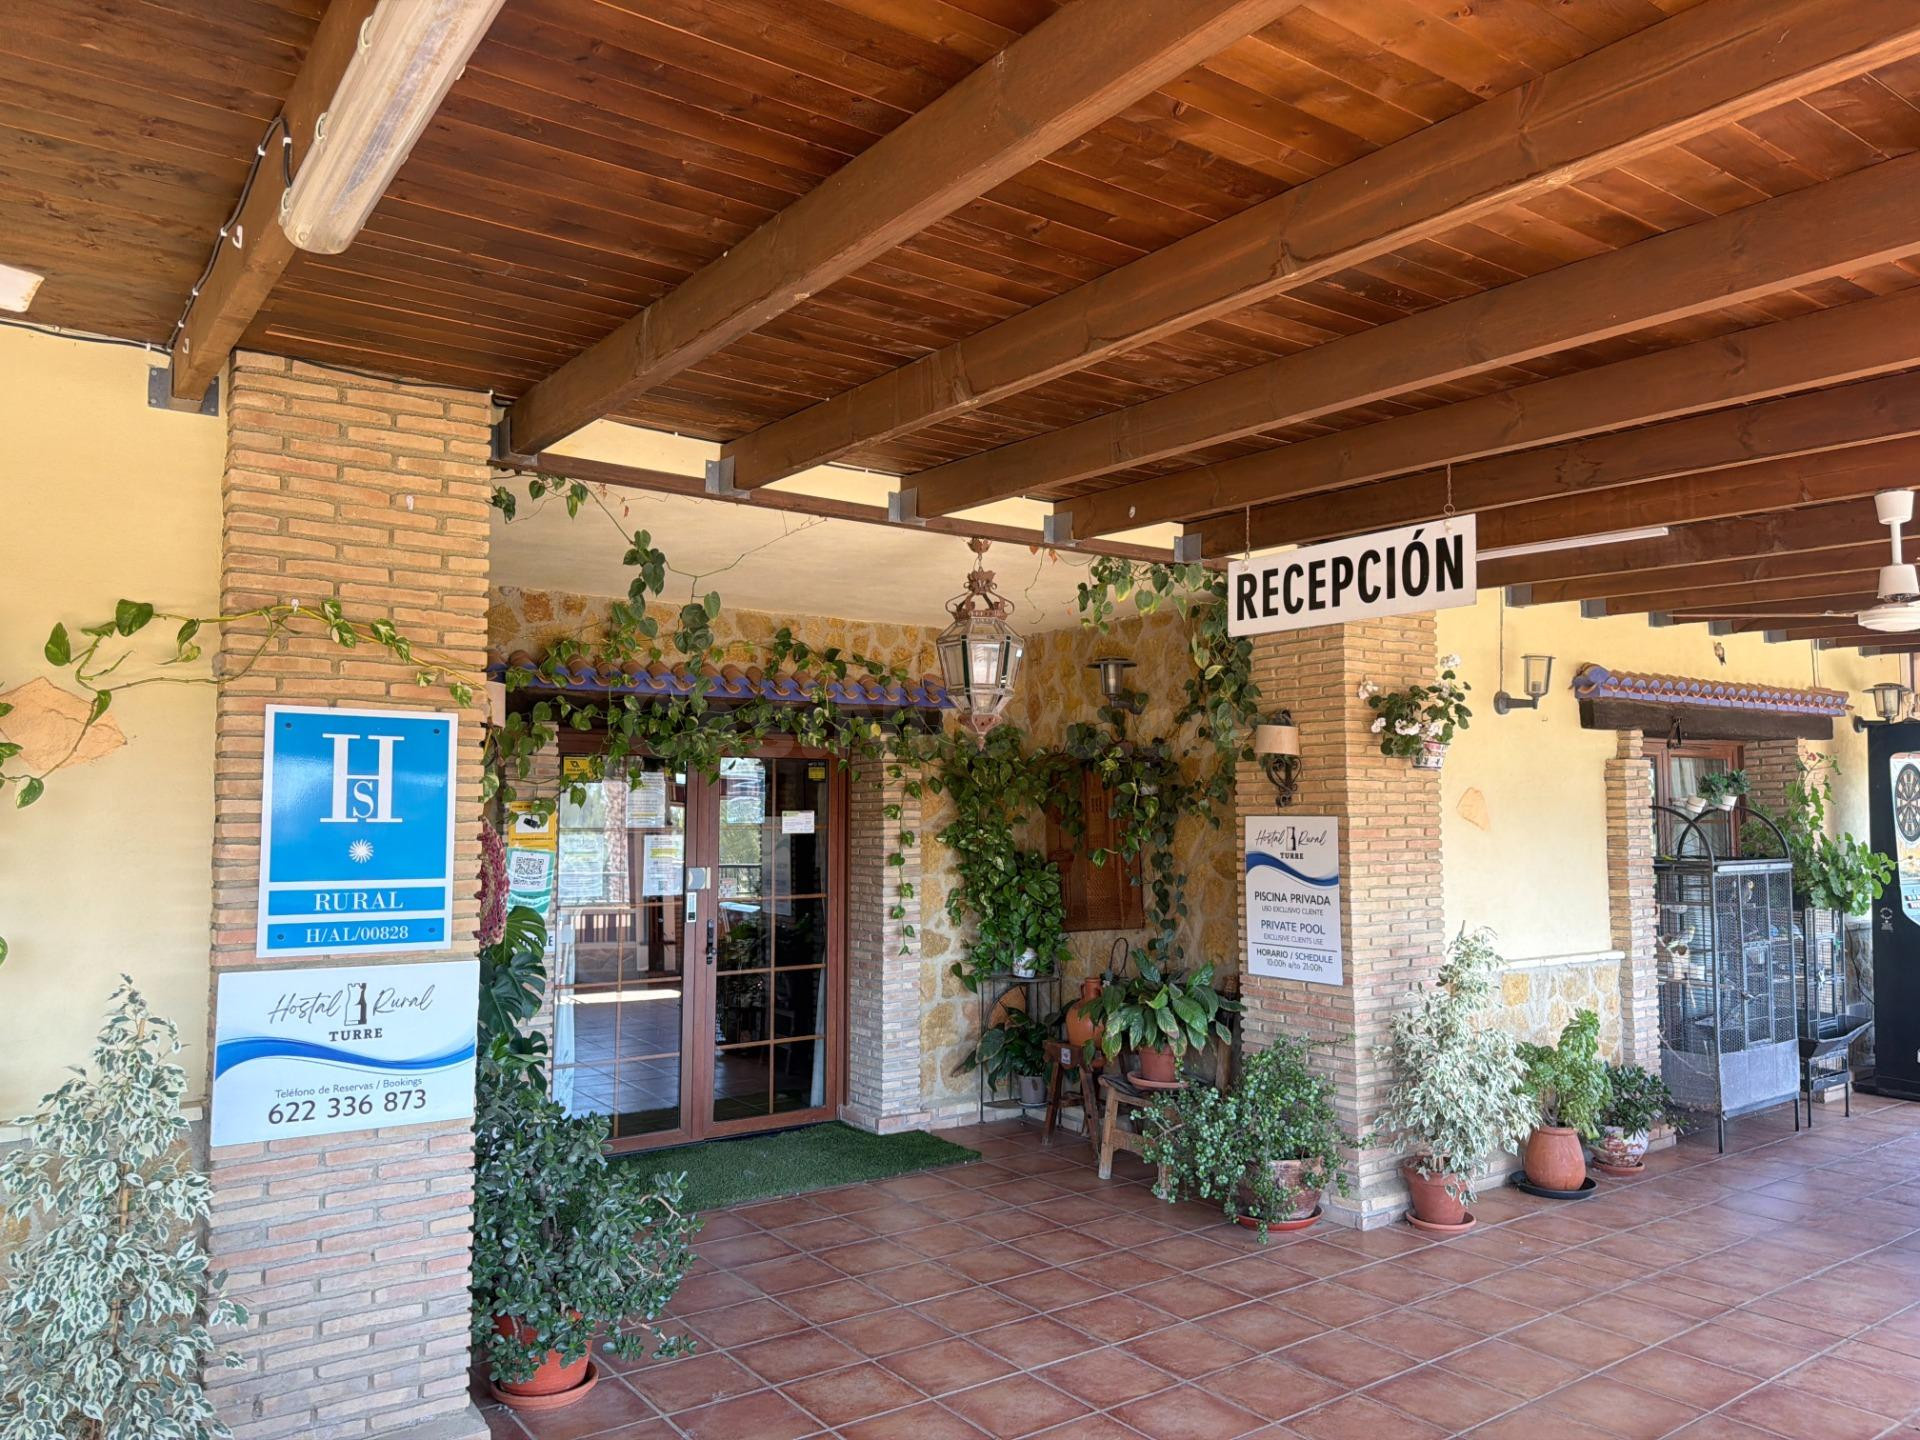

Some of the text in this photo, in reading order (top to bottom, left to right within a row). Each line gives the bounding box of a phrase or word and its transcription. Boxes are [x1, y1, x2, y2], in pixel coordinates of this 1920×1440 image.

[1236, 528, 1464, 621] RECEPCIÓN
[1255, 828, 1328, 848] Hostal Rural
[1279, 852, 1304, 860] TURRE
[313, 890, 405, 912] RURAL
[1254, 890, 1332, 906] PISCINA PRIVADA
[1261, 904, 1324, 916] USO EXCLUSIVO CLIENTE
[305, 924, 410, 944] H/AL/00828
[1260, 919, 1326, 935] PRIVATE POOL
[1263, 932, 1324, 946] EXCLUSIVE CLIENTS USE
[1256, 947, 1289, 959] HORARIO
[1294, 951, 1334, 964] SCHEDULE
[267, 984, 436, 1025] Hostal Rural
[328, 1027, 384, 1042] TURRE
[275, 1087, 316, 1099] Teléfono
[318, 1084, 331, 1095] de
[332, 1081, 374, 1093] Reservas
[383, 1076, 424, 1089] Bookings
[267, 1088, 427, 1125] 622 336 873
